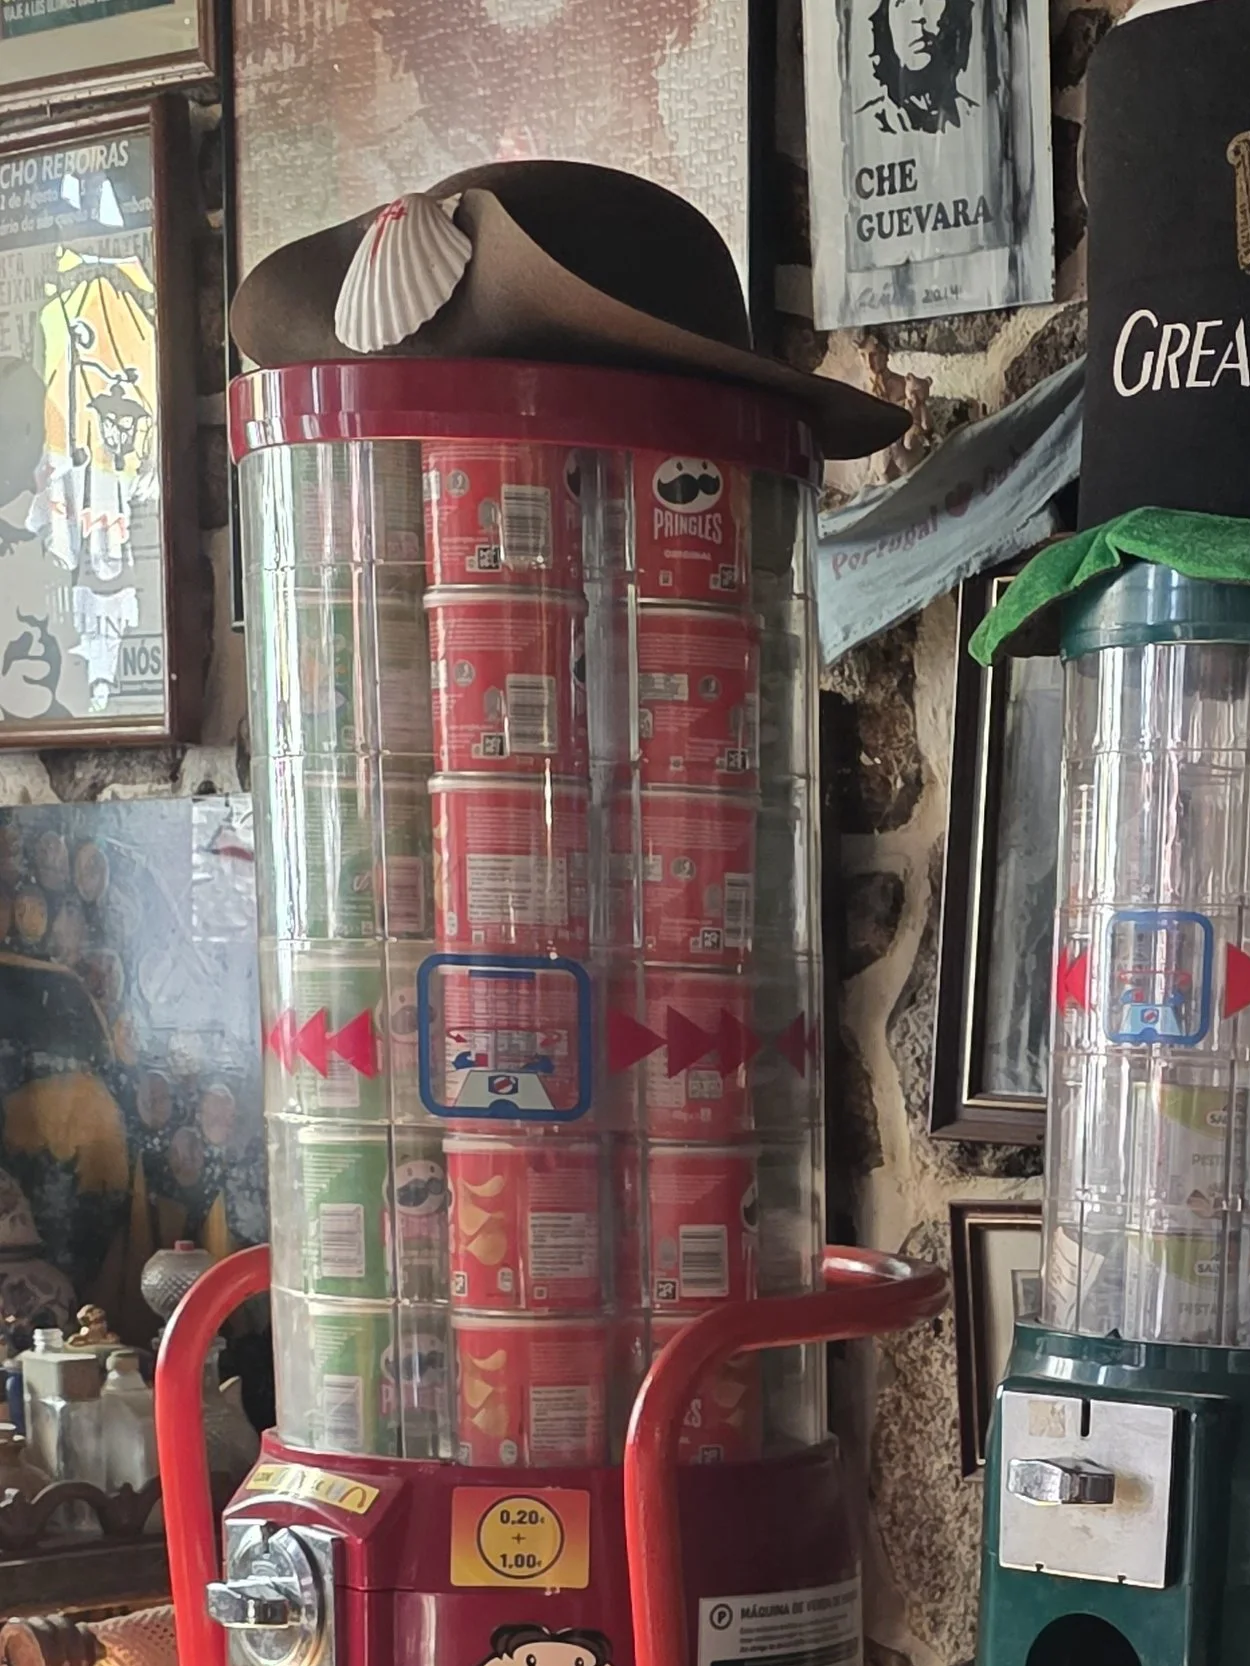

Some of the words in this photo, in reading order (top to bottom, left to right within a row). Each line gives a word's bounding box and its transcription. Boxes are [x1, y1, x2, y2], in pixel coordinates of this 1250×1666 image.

[42, 139, 130, 181] REBOIRAS
[855, 159, 918, 200] CHE
[856, 195, 994, 243] GUEVARA
[653, 507, 722, 545] PRINGLES
[830, 504, 940, 581] Portugal
[122, 639, 162, 677] NÓS
[740, 1602, 790, 1620] MÁQUINA
